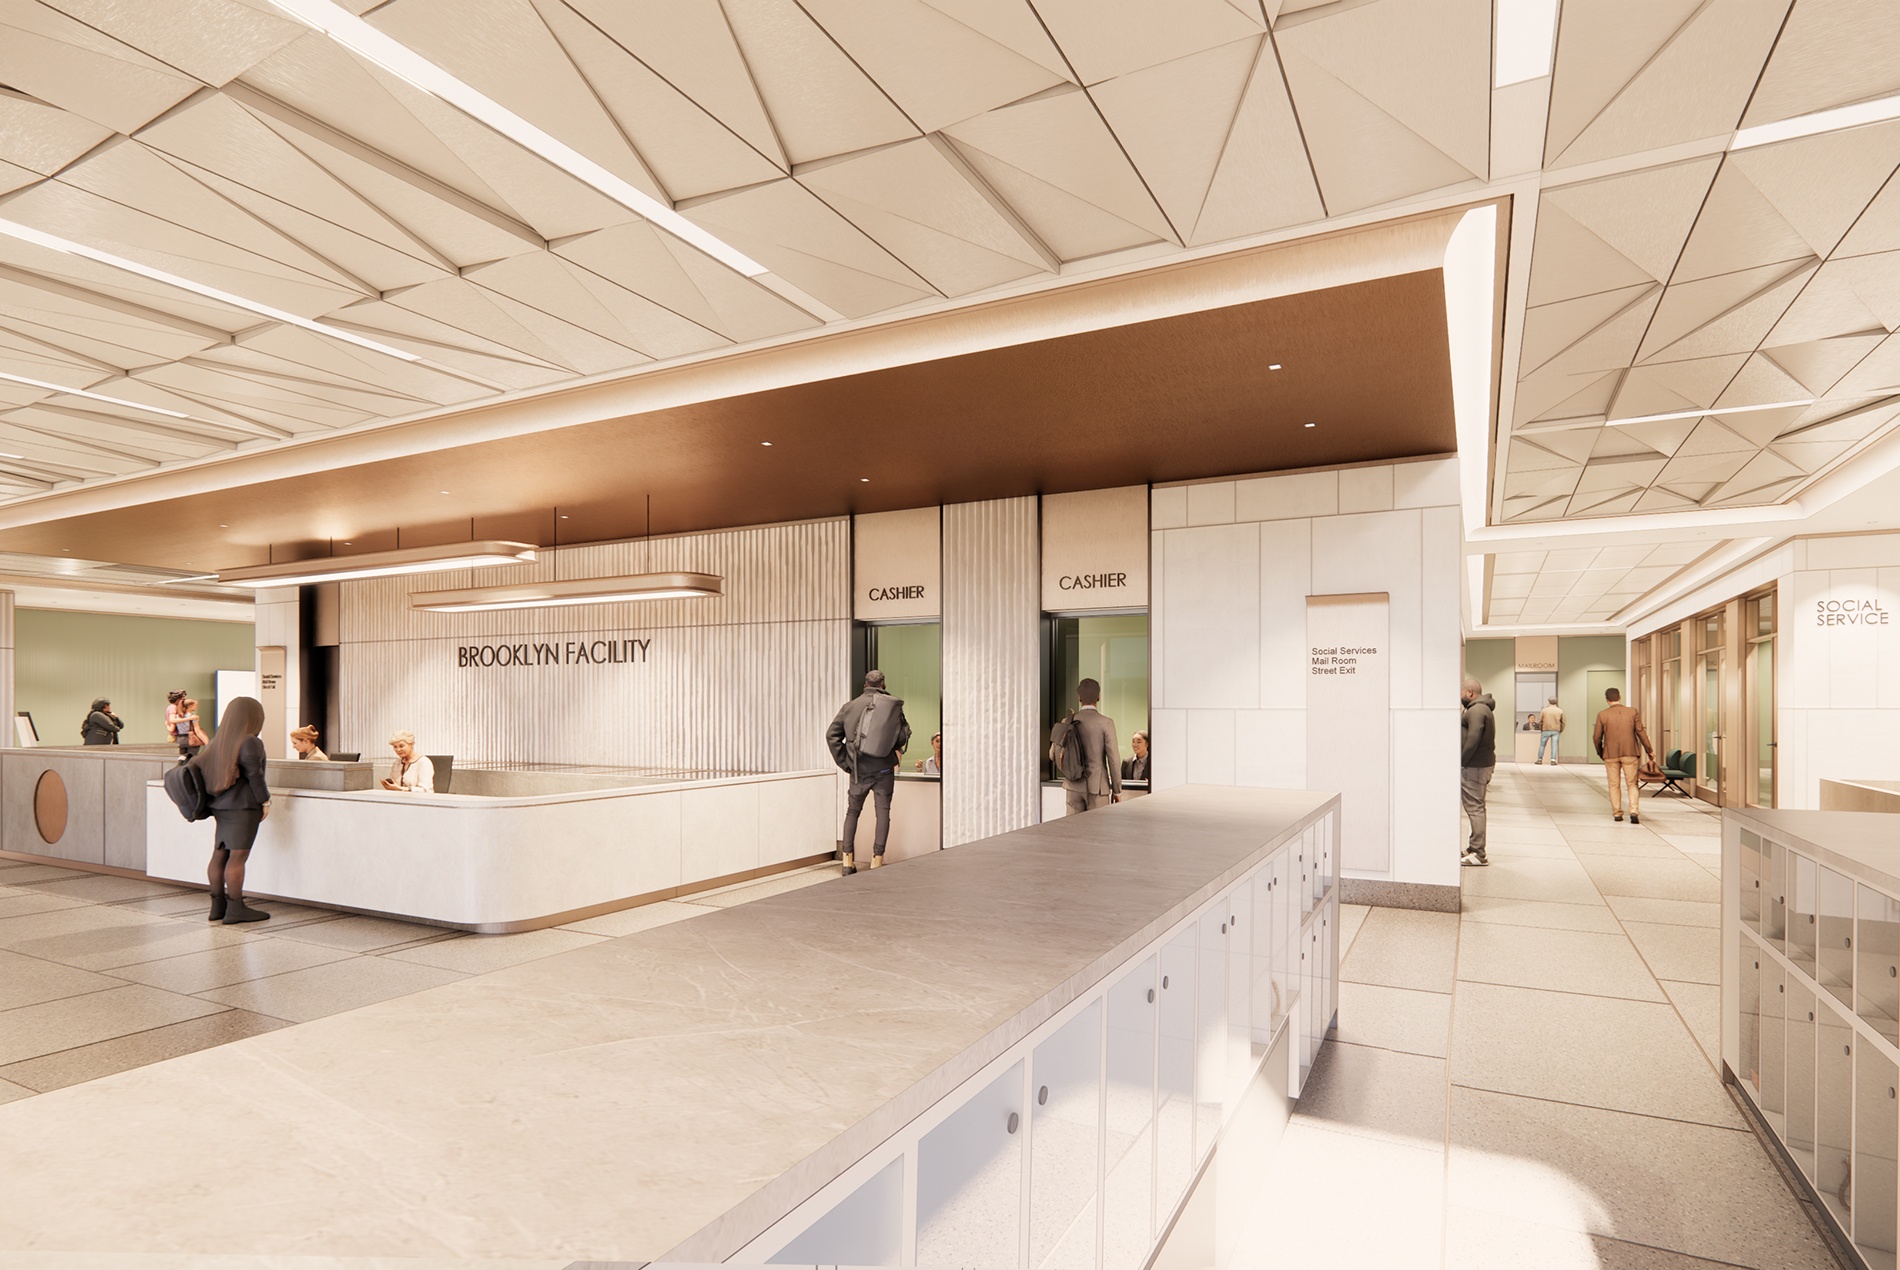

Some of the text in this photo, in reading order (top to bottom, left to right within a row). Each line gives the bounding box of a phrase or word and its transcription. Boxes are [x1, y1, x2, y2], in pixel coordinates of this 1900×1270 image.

[1059, 572, 1127, 590] CASHIER
[868, 585, 925, 601] CASHIER
[1817, 599, 1882, 613] SOCIAL
[1817, 612, 1889, 627] SERVICE
[458, 638, 651, 667] BROOKLYN FACILITY
[1311, 646, 1377, 656] Social Services
[1311, 656, 1357, 665] Mail Room
[1311, 666, 1356, 676] Street Exit
